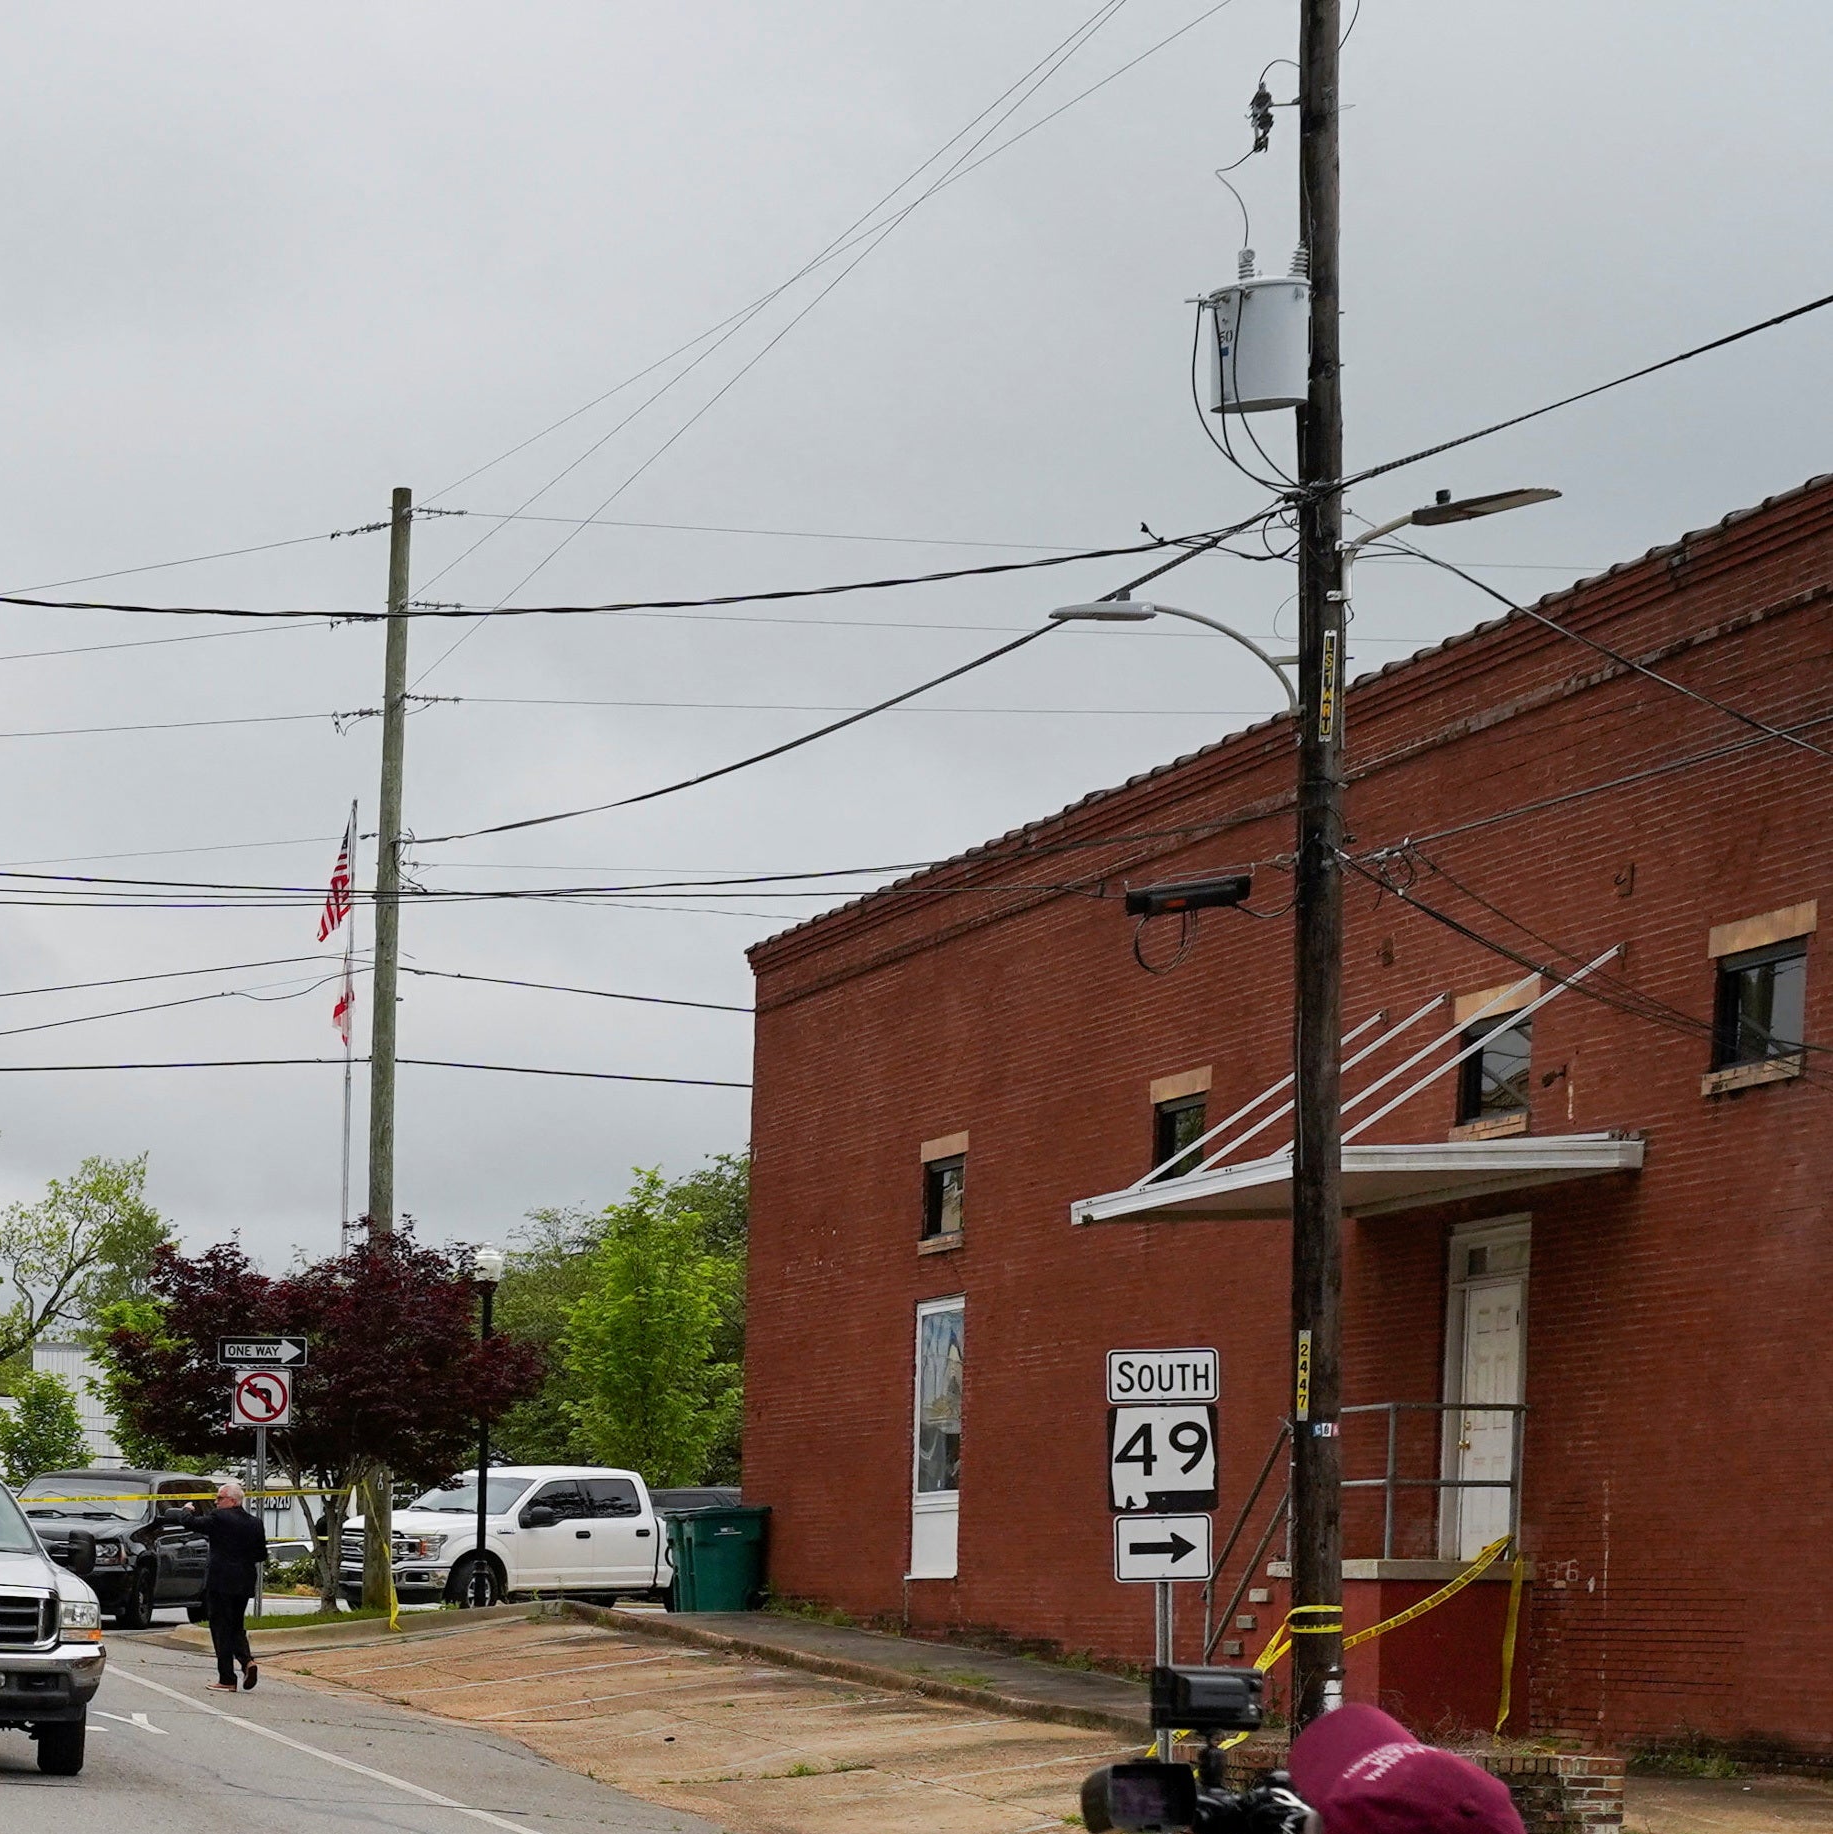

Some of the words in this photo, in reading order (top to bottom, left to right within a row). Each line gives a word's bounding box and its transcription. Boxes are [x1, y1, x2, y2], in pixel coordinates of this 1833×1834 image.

[228, 1345, 251, 1356] ONE
[256, 1346, 280, 1356] WAY
[1116, 1361, 1210, 1393] SOUTH
[1297, 1343, 1309, 1408] 2447
[1114, 1421, 1208, 1476] 49
